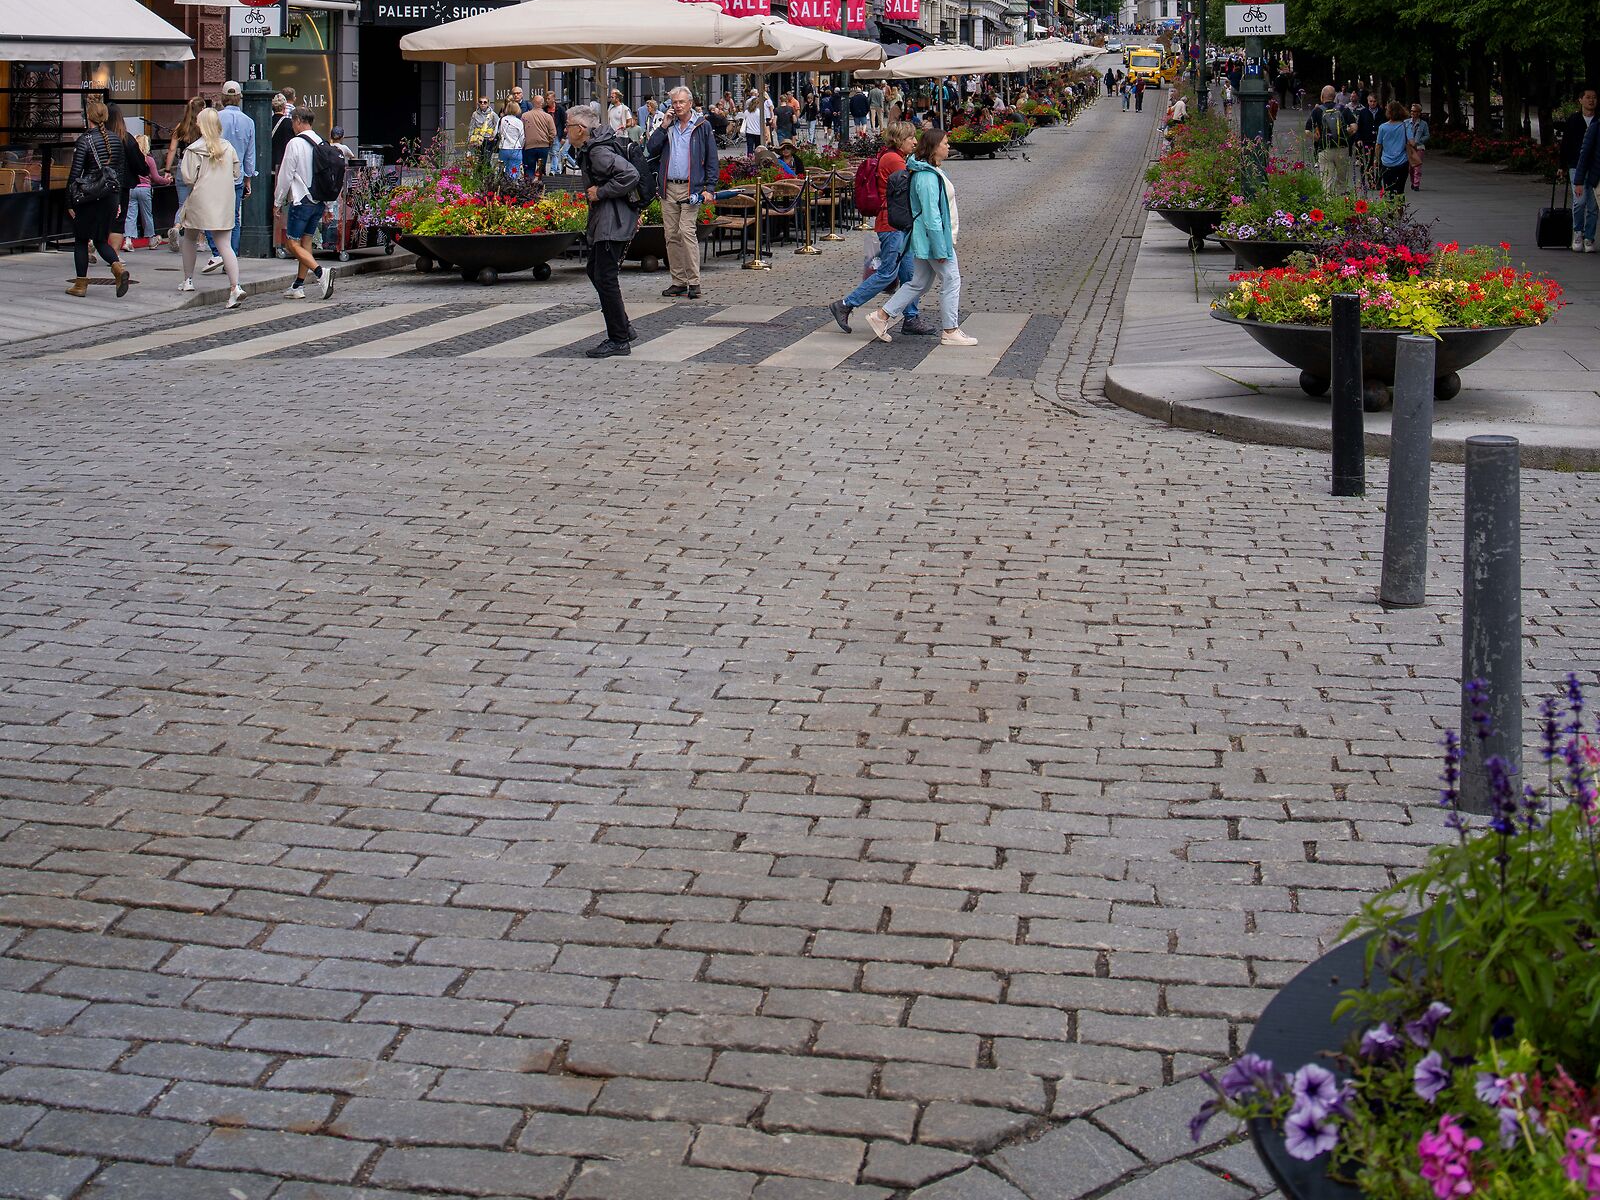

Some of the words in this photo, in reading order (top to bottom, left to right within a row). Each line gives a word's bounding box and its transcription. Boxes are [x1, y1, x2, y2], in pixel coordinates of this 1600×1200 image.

[378, 5, 427, 18] PALEET
[453, 6, 500, 18] SHOP
[790, 1, 831, 18] SALE
[885, 0, 919, 13] SALE
[836, 7, 864, 22] ALE
[240, 26, 270, 34] unnta
[1239, 24, 1272, 33] unntatt
[107, 76, 136, 92] Nature
[458, 90, 474, 102] SALE
[496, 89, 511, 101] SALE
[531, 88, 544, 99] SALE
[302, 94, 326, 108] SALE
